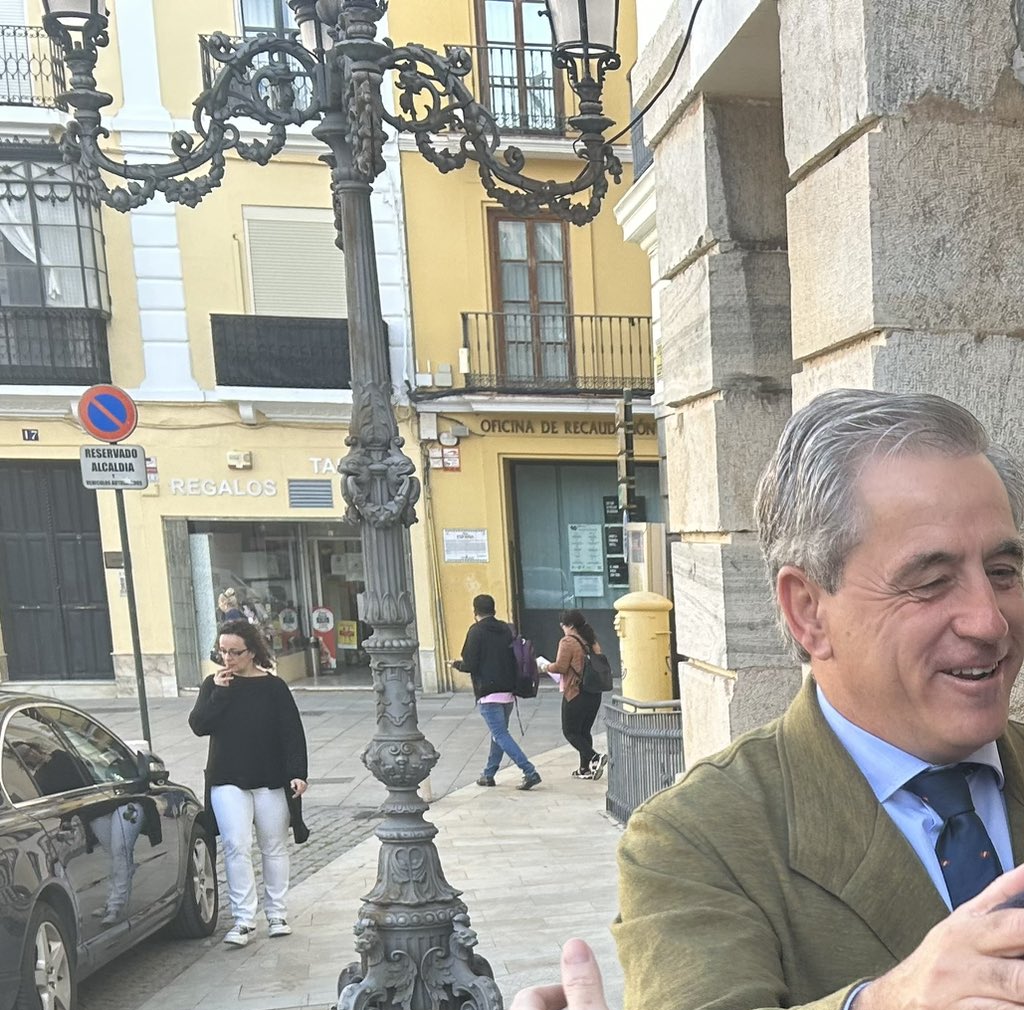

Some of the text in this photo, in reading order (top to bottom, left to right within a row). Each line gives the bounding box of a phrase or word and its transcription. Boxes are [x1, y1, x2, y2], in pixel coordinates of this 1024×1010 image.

[480, 419, 535, 434] OFICINA
[541, 420, 559, 434] DE
[24, 430, 38, 440] 17
[85, 448, 138, 459] RESERVADO
[91, 462, 135, 472] ALCALDIA
[309, 457, 341, 474] TA
[170, 479, 277, 497] REGALOS
